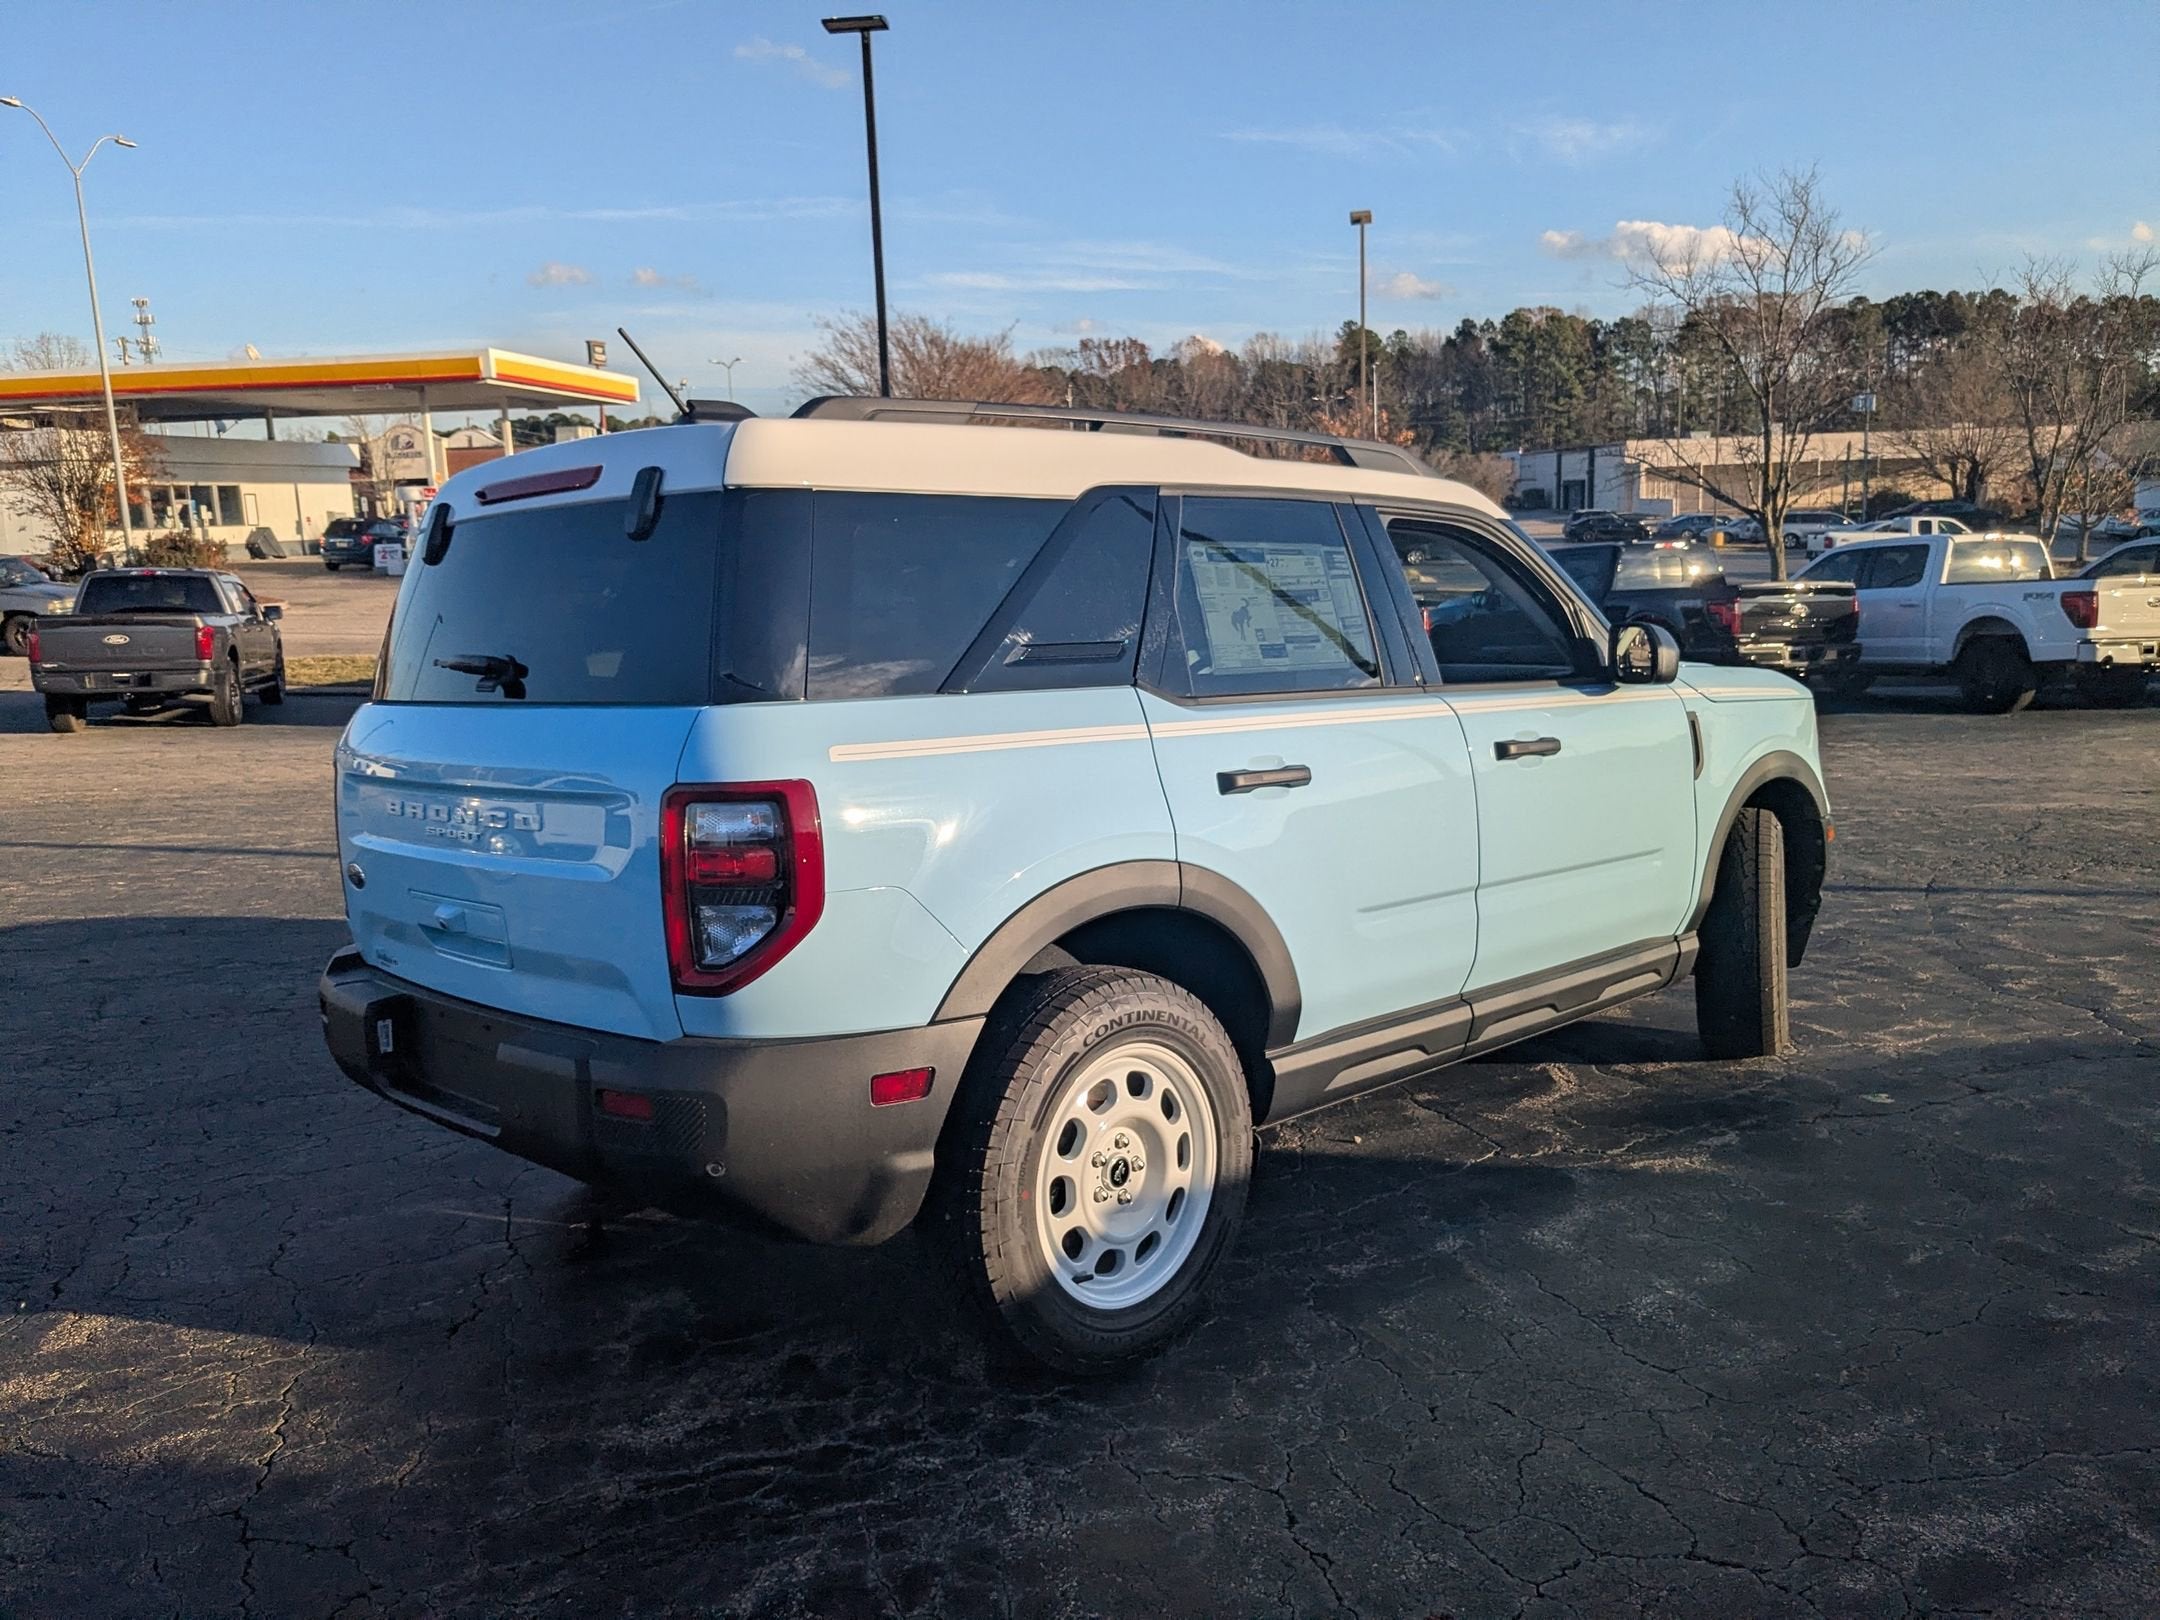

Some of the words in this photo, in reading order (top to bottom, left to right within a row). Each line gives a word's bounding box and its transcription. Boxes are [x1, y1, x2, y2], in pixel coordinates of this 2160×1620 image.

[385, 800, 543, 832] BRONCO
[423, 827, 483, 841] SPORT
[1082, 1008, 1207, 1048] CONTINENTAL
